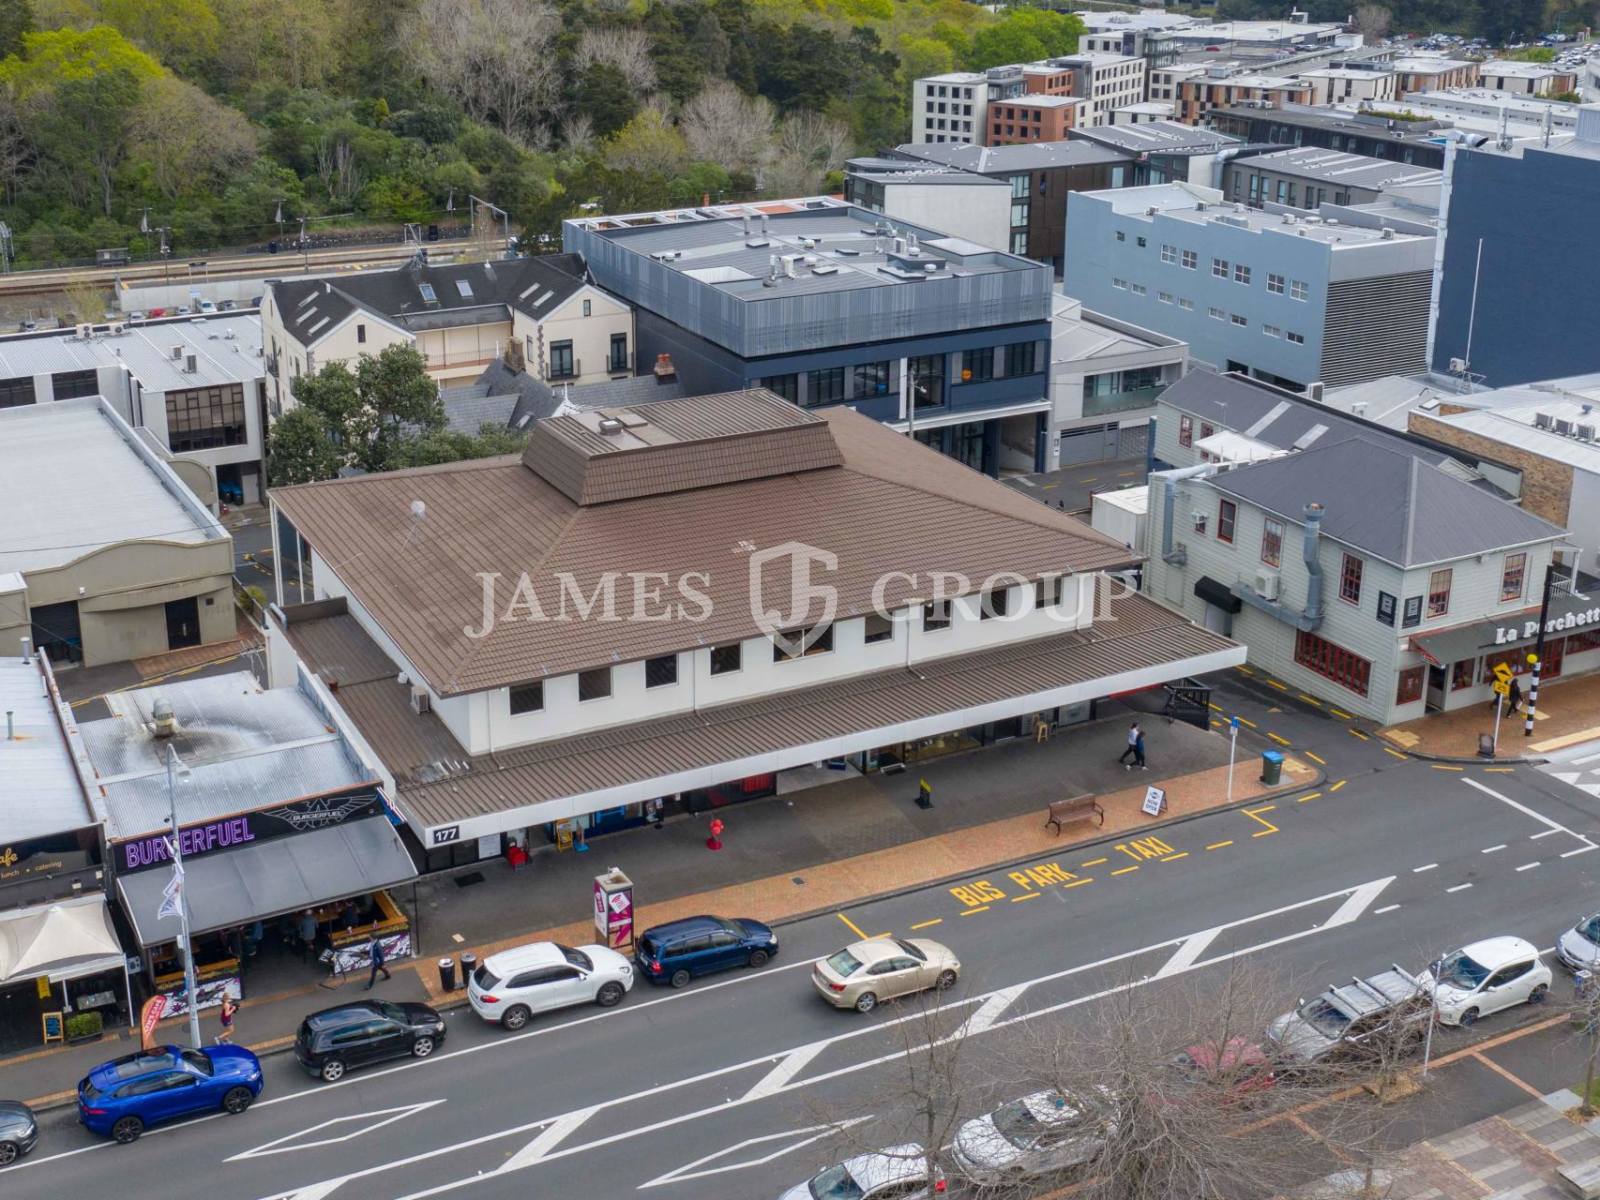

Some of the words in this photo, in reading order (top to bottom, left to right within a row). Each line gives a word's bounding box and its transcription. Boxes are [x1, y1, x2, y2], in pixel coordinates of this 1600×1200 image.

[1495, 627, 1518, 645] La
[1523, 607, 1600, 638] Prchett
[435, 827, 457, 842] 177
[949, 879, 1006, 907] BUS
[1008, 862, 1079, 891] PARK
[1114, 836, 1175, 862] TAXI
